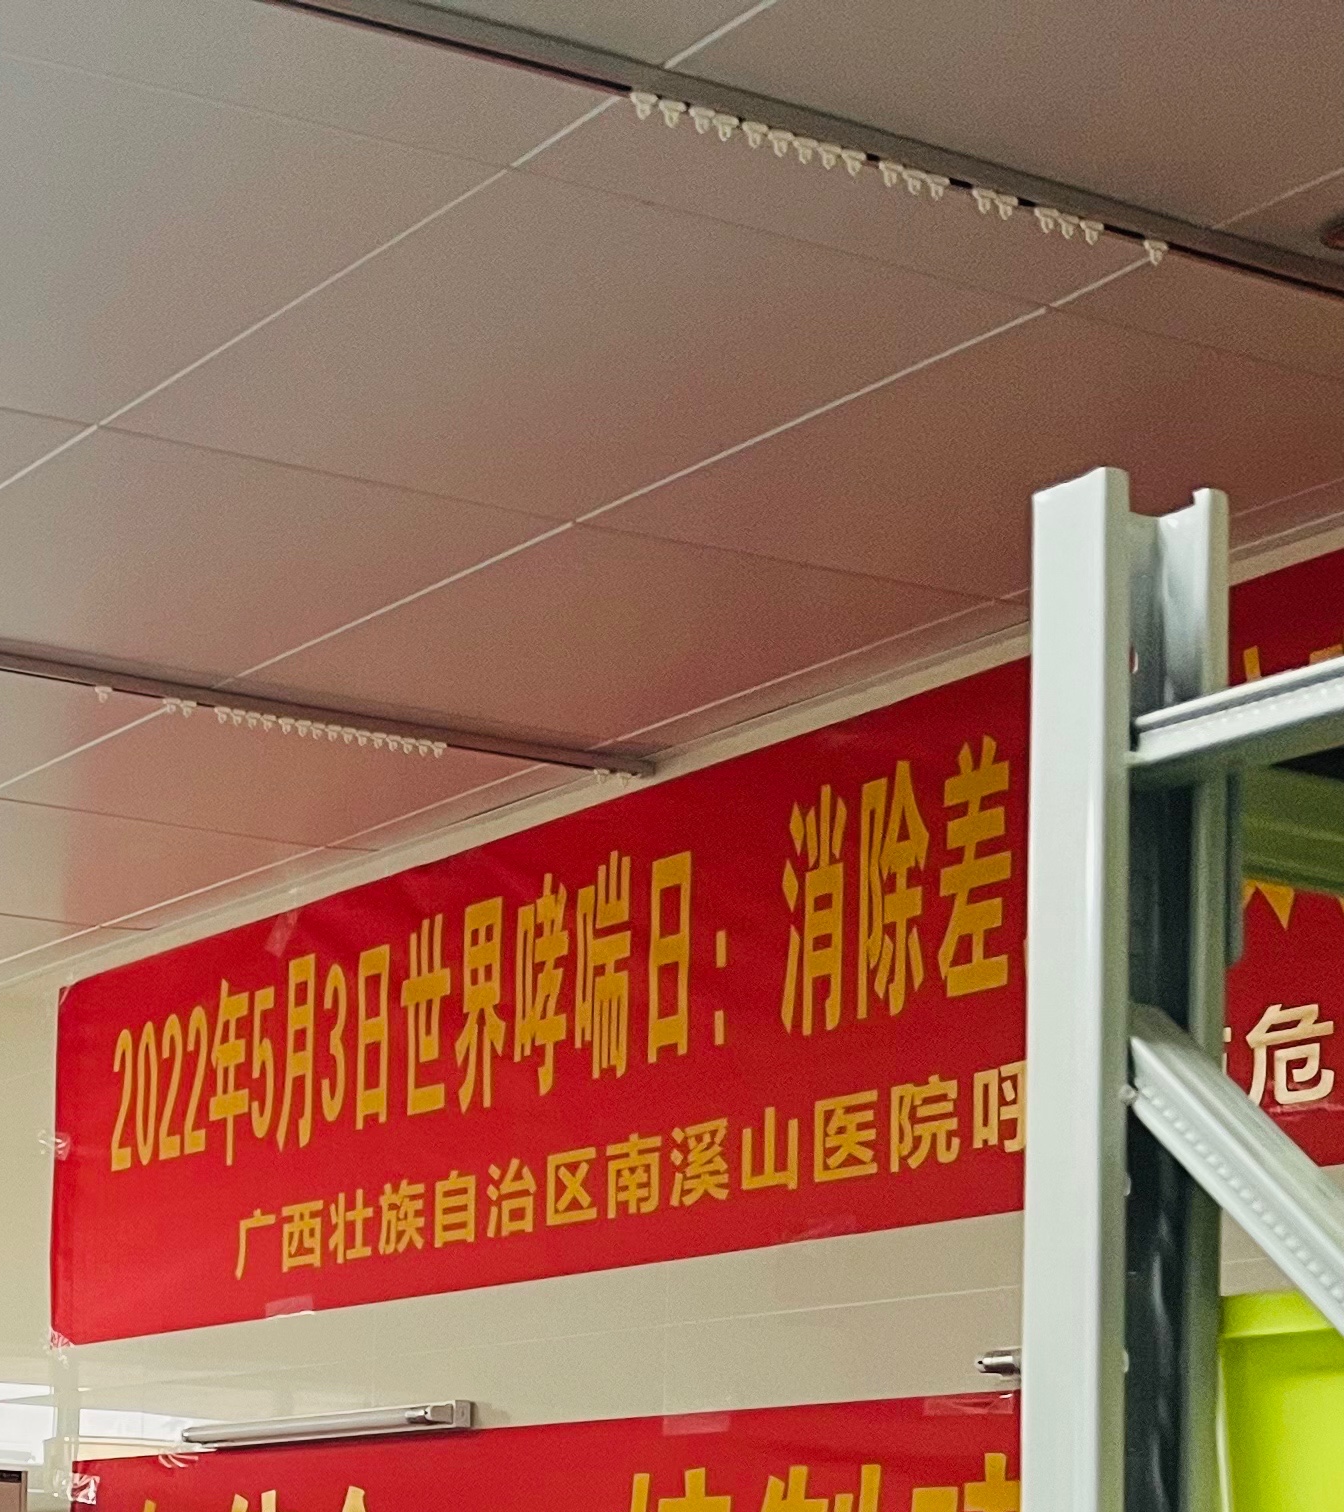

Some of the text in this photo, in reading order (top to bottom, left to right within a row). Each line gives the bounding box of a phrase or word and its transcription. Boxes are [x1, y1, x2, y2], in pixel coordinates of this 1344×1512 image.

[111, 735, 1029, 1172] 2022年5月3日世界哮喘日：消除差
[1223, 1003, 1334, 1106] 危
